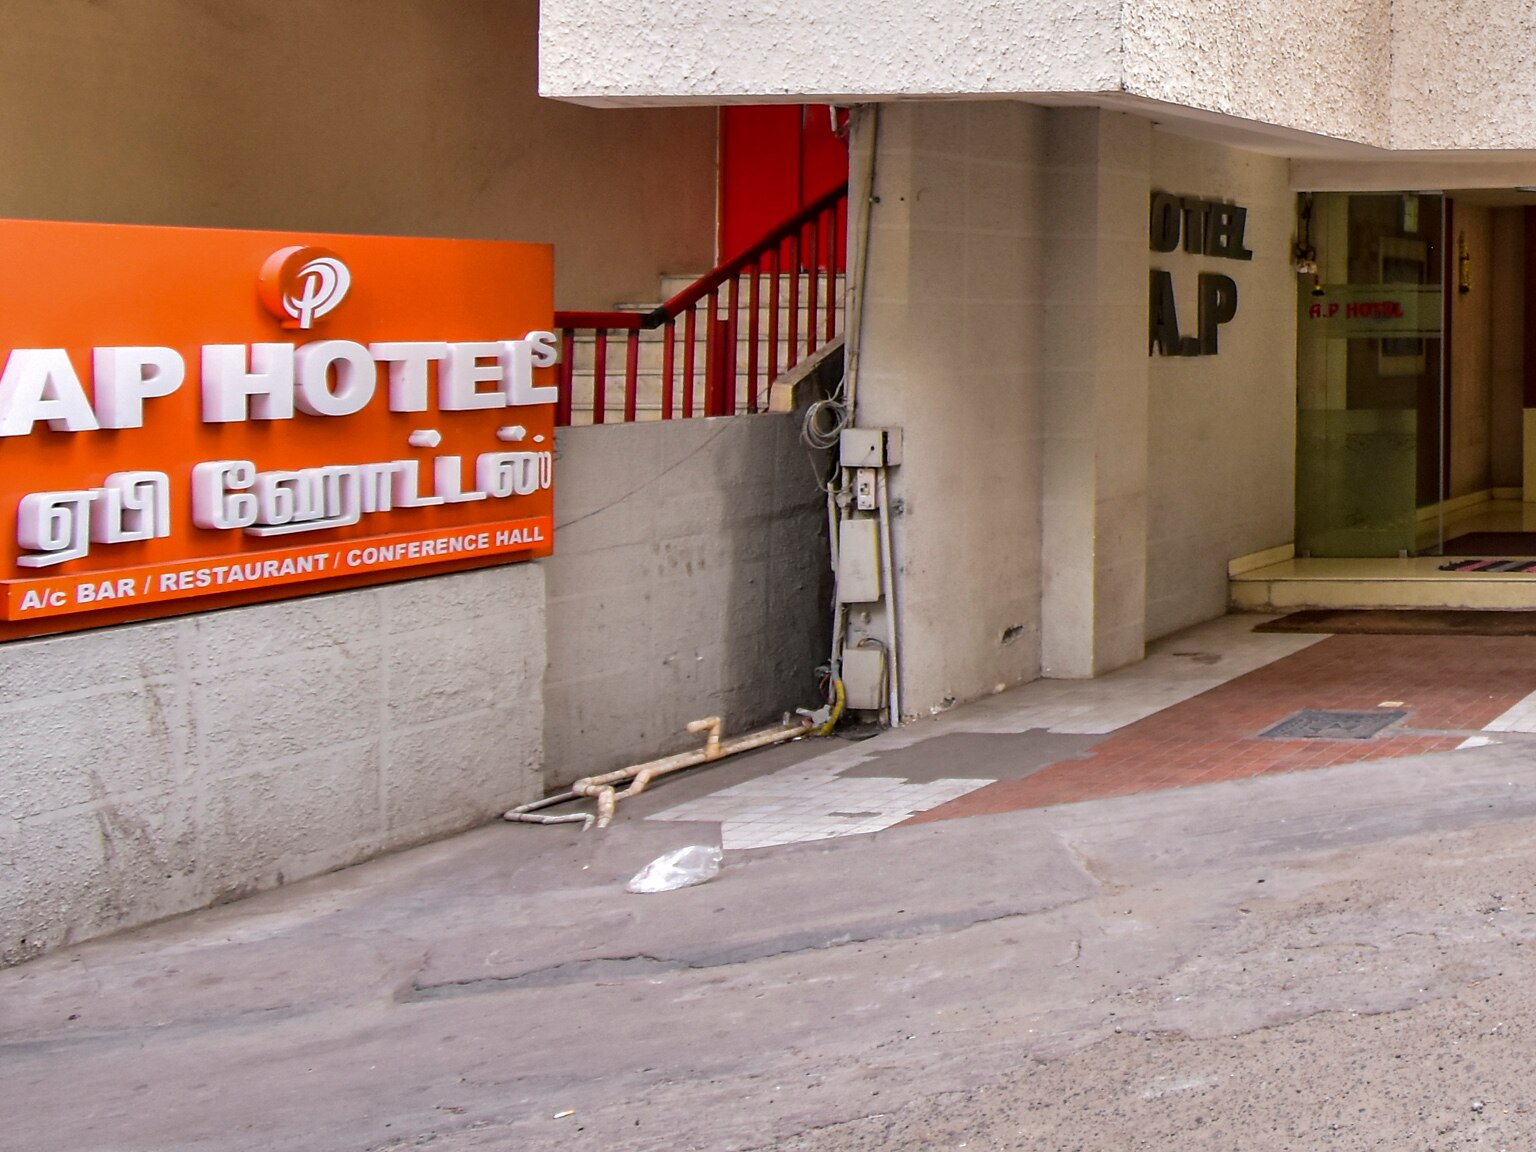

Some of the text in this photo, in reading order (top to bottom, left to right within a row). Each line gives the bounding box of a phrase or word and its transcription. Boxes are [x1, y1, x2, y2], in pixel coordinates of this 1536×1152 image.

[1149, 192, 1252, 260] OTEL
[1346, 301, 1403, 319] HOTEL
[0, 331, 558, 436] AP HOTELS
[77, 579, 136, 603] BAR
[143, 576, 151, 594] /
[160, 553, 329, 592] RESTAURANT
[333, 552, 341, 568] /
[347, 532, 489, 567] CONFERENCE
[495, 527, 544, 546] HALL
